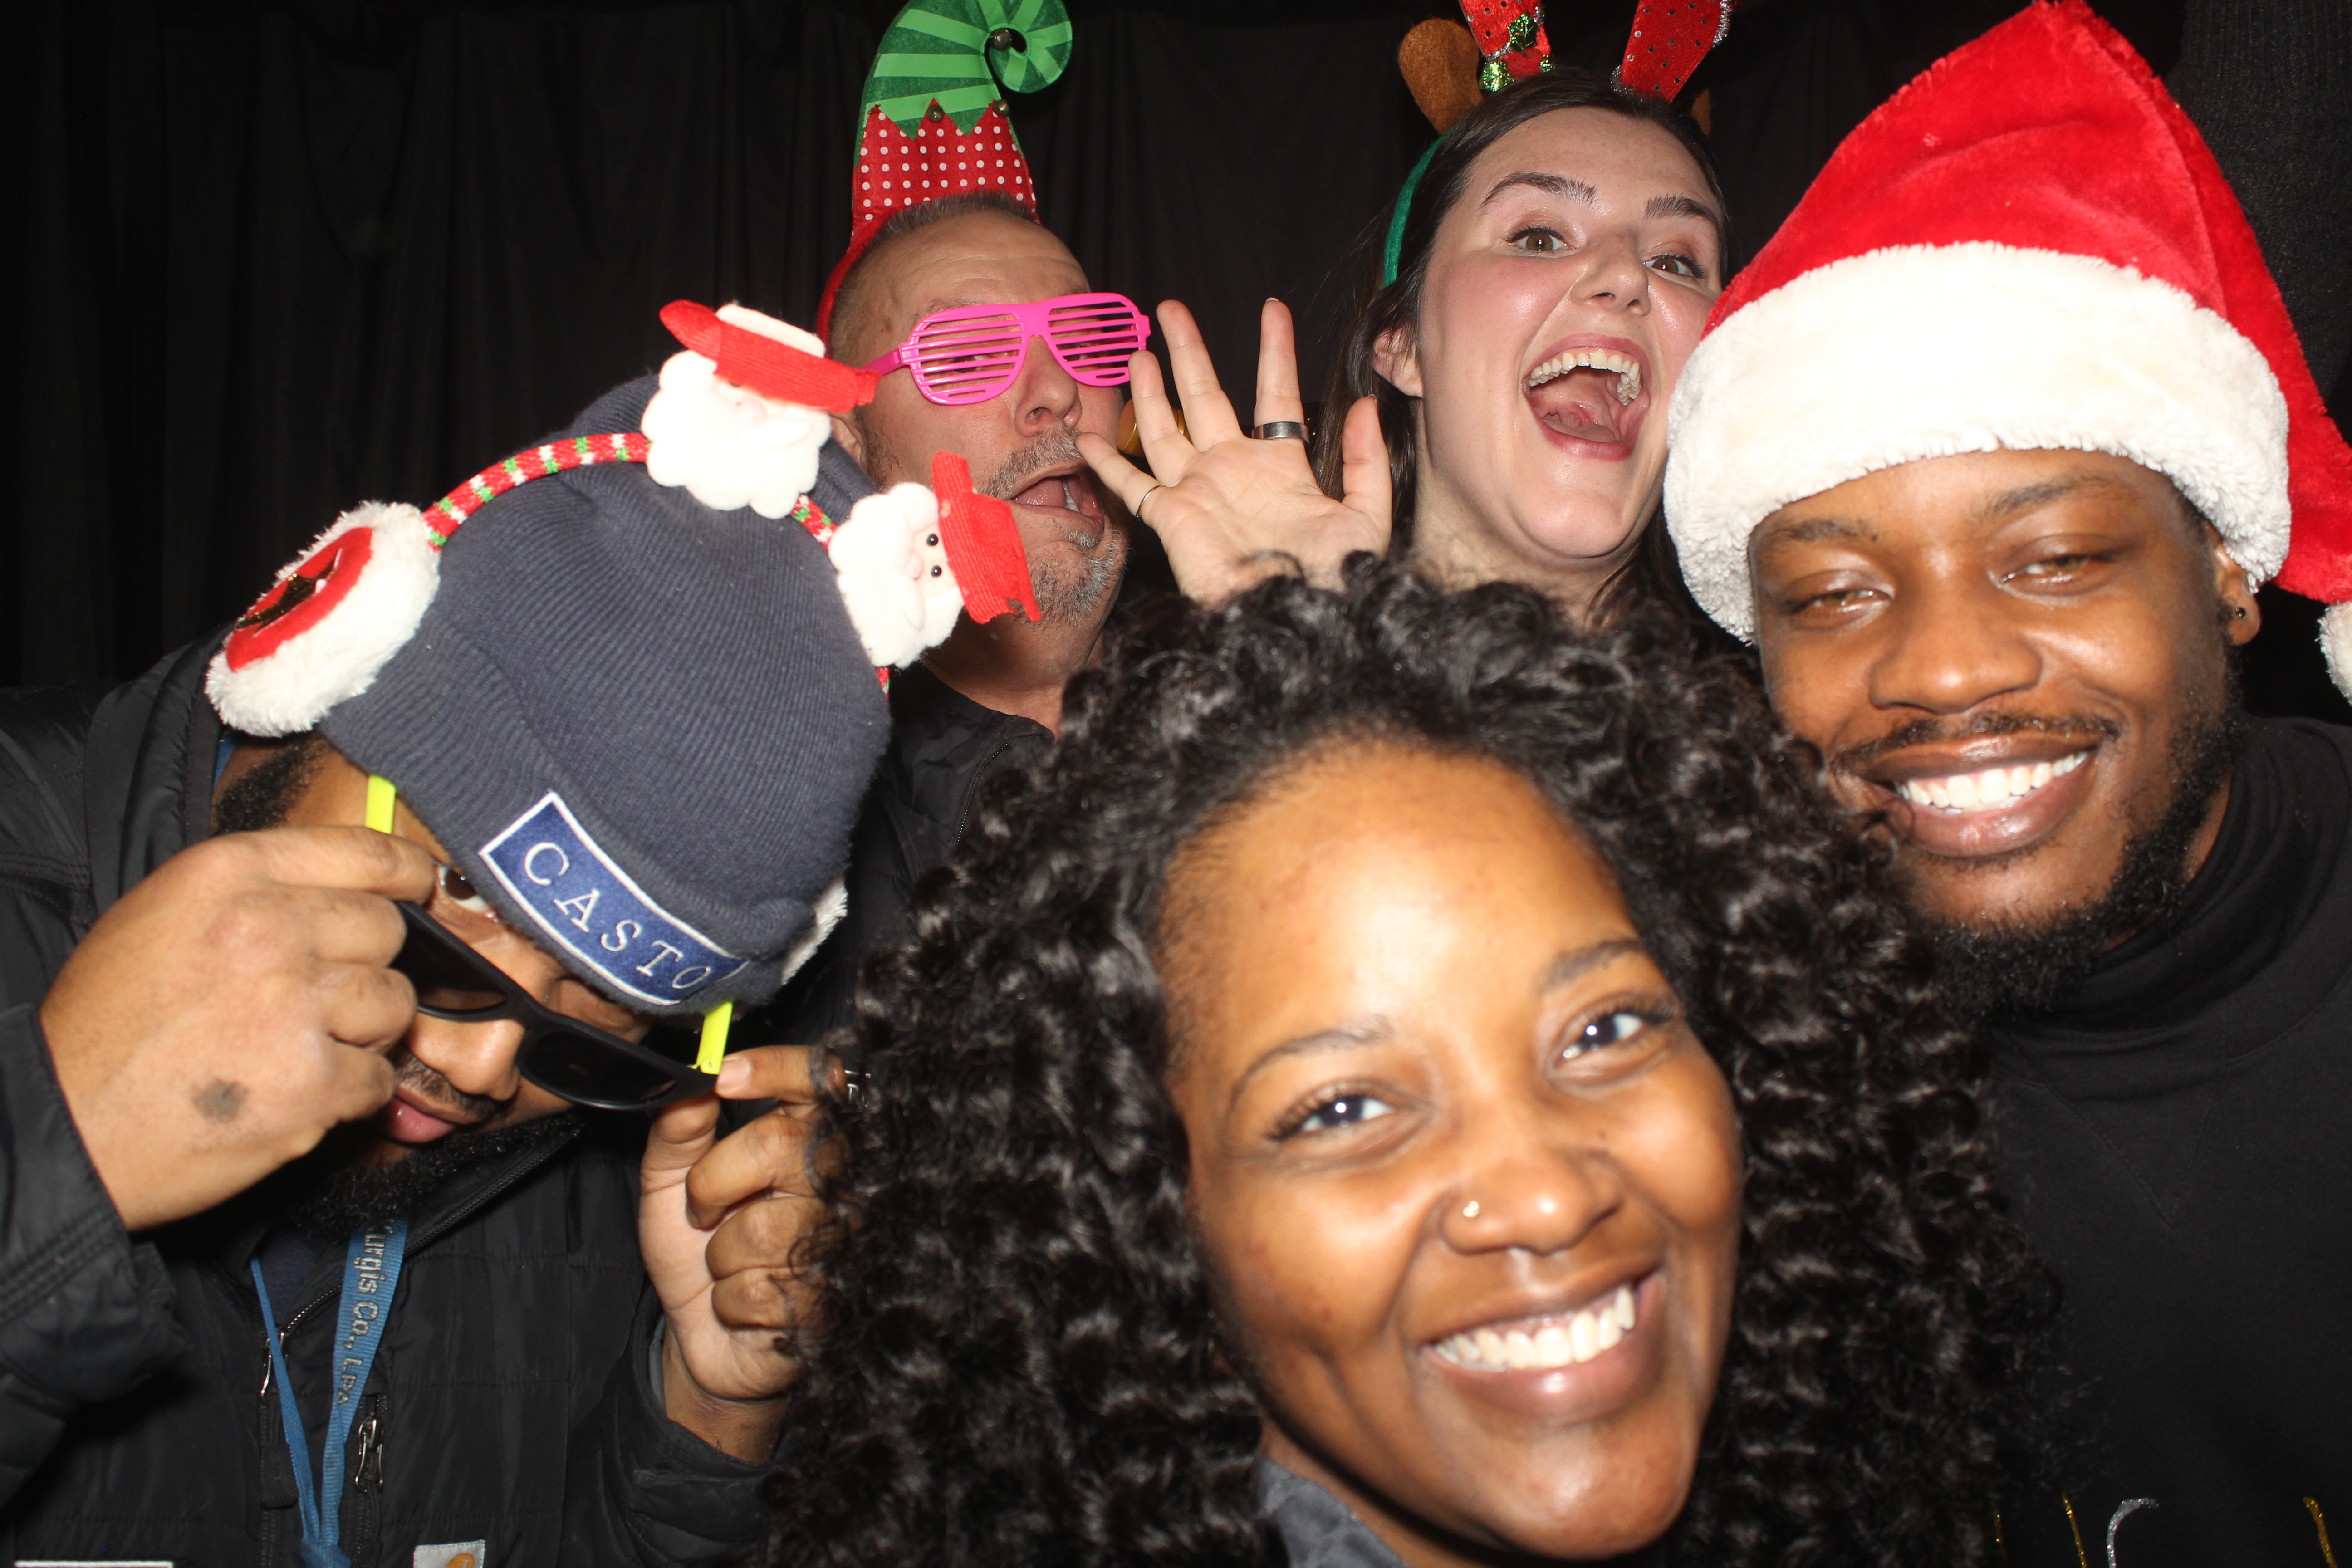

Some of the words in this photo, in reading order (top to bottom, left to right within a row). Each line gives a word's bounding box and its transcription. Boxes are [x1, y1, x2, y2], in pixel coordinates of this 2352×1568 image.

[524, 842, 711, 990] CASTO
[353, 1219, 393, 1294] urgis
[343, 1301, 379, 1349] Co.,
[338, 1358, 363, 1404] LPA
